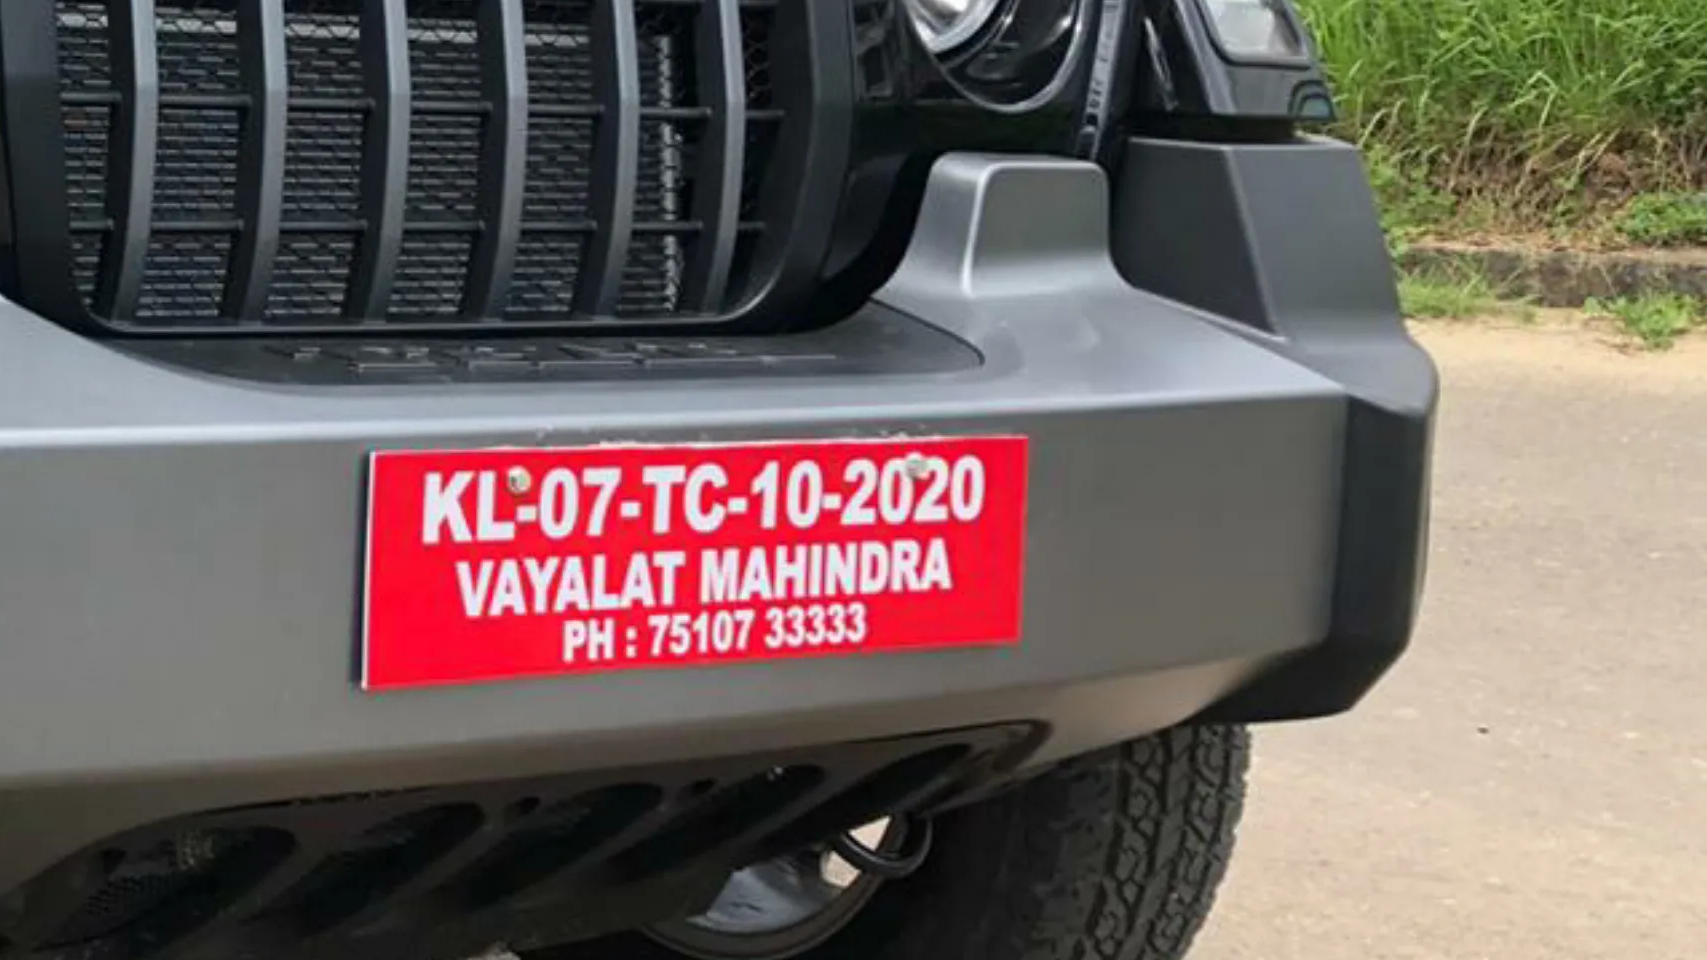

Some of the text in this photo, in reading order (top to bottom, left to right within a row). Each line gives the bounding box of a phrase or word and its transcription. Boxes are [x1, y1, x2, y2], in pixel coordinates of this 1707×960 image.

[422, 455, 986, 544] KL-07-TC-10-2020
[455, 537, 953, 617] VAYALAT MAHINDRA
[563, 618, 615, 662] PH
[648, 609, 756, 657] 75107
[764, 602, 867, 649] 33333
